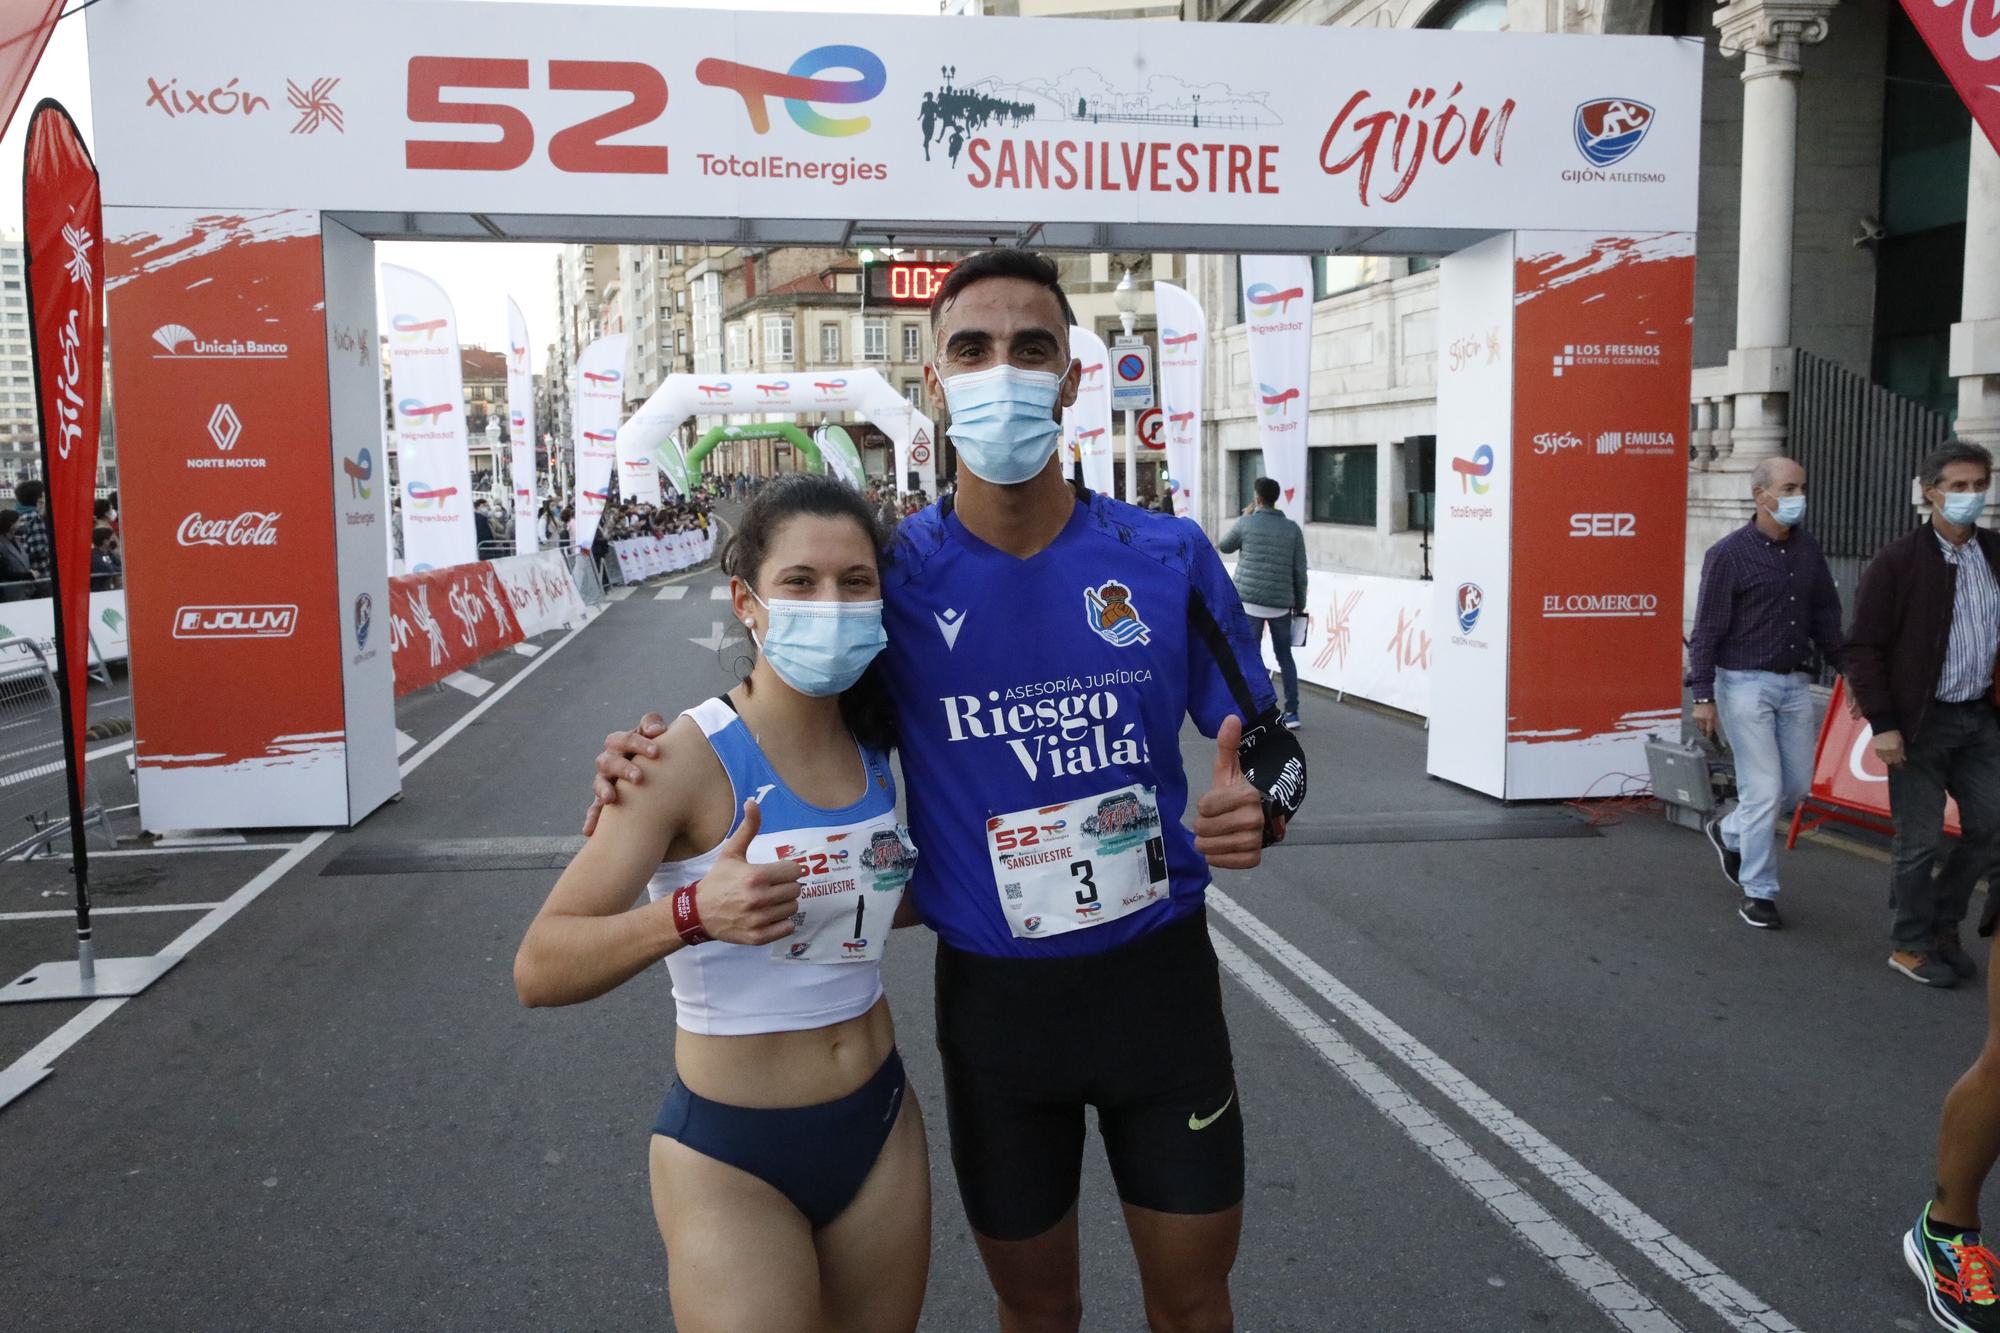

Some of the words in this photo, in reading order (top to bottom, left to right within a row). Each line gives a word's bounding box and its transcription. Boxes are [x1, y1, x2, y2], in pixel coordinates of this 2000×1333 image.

[405, 55, 668, 174] 52
[1319, 81, 1516, 207] Gijón
[696, 153, 887, 185] TotalEnergies
[967, 138, 1280, 194] SANSILVESTRE
[1562, 168, 1606, 184] GIJÓN
[1609, 172, 1666, 184] ATLETISMO
[193, 339, 245, 356] Unicaja
[246, 341, 288, 353] Banco
[1576, 345, 1601, 355] LOS
[1605, 345, 1661, 356] FRESNOS
[1576, 357, 1610, 365] CENTRO
[1612, 357, 1660, 365] COMERCIAL
[1625, 432, 1675, 445] EMULSA
[187, 459, 225, 468] NORTE
[226, 459, 266, 468] MOTOR
[177, 511, 282, 546] Coca-Cola
[1543, 595, 1562, 611] EL
[1566, 594, 1657, 611] COMERCIO
[1005, 676, 1082, 701] ASESORÍA
[1085, 669, 1152, 689] JURÍDICA
[940, 690, 1119, 742] Riesgo
[995, 825, 1040, 851] 52
[1007, 846, 1073, 870] SANSILVESTRE
[801, 878, 855, 899] SANSILVESTRE
[1070, 860, 1098, 905] 3
[853, 895, 865, 939] 1
